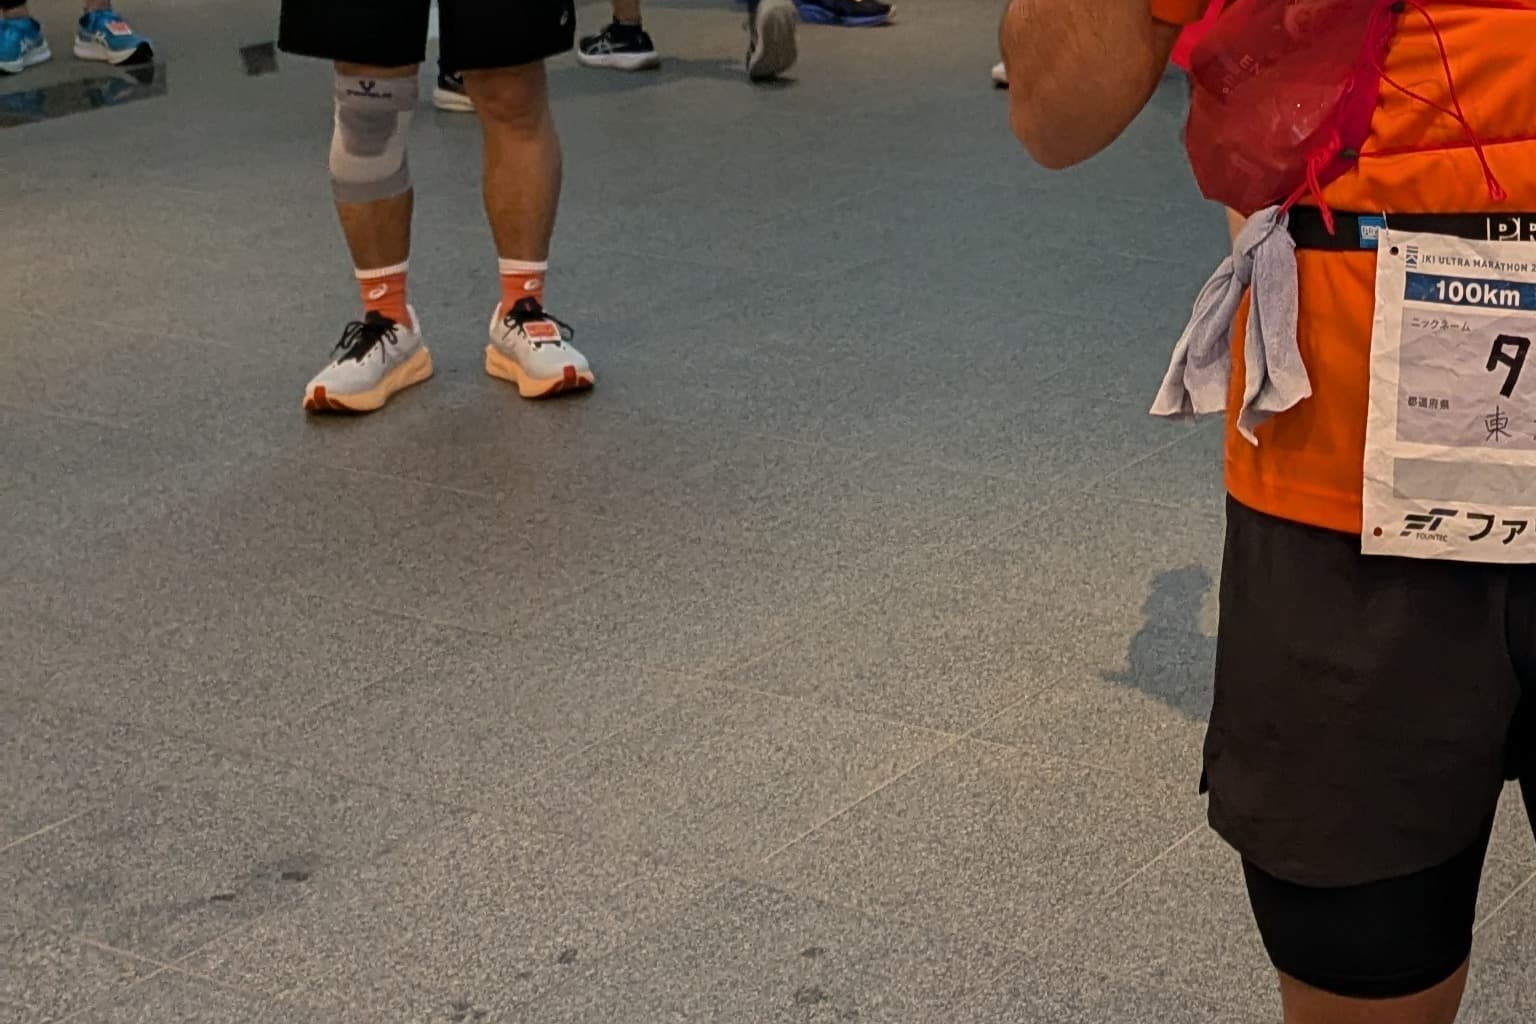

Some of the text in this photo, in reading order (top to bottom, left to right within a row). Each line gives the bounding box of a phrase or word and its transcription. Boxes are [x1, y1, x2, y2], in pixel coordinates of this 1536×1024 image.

[1421, 254, 1436, 266] IKI
[1438, 256, 1470, 268] ULTRA
[1473, 259, 1529, 273] MARATHON
[1435, 281, 1521, 307] 100km
[1411, 317, 1472, 333] ニックネーム
[1407, 395, 1449, 410] 都道府県
